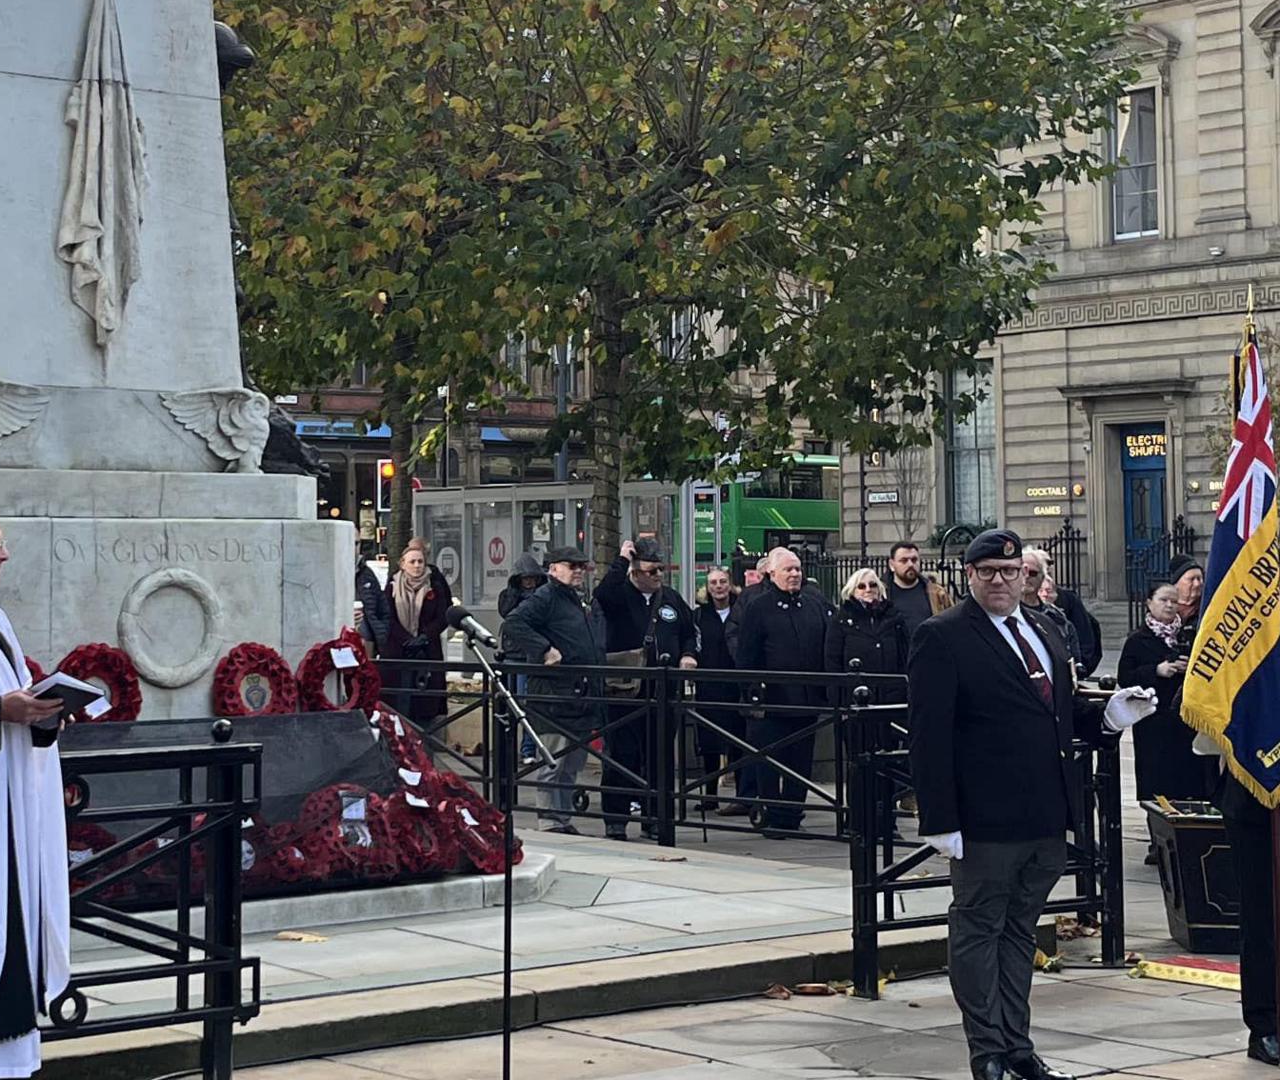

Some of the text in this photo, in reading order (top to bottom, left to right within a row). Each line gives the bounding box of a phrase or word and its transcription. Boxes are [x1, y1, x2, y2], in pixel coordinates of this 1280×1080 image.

[1126, 434, 1169, 447] ELECTRI
[1128, 444, 1167, 458] SHUFFL
[1026, 486, 1068, 497] COCKTAILS
[1209, 481, 1224, 490] BRU
[1033, 505, 1062, 516] GAMES
[1228, 587, 1280, 662] LEEDS CEN
[1190, 636, 1228, 683] THE
[1215, 585, 1261, 642] ROYAL
